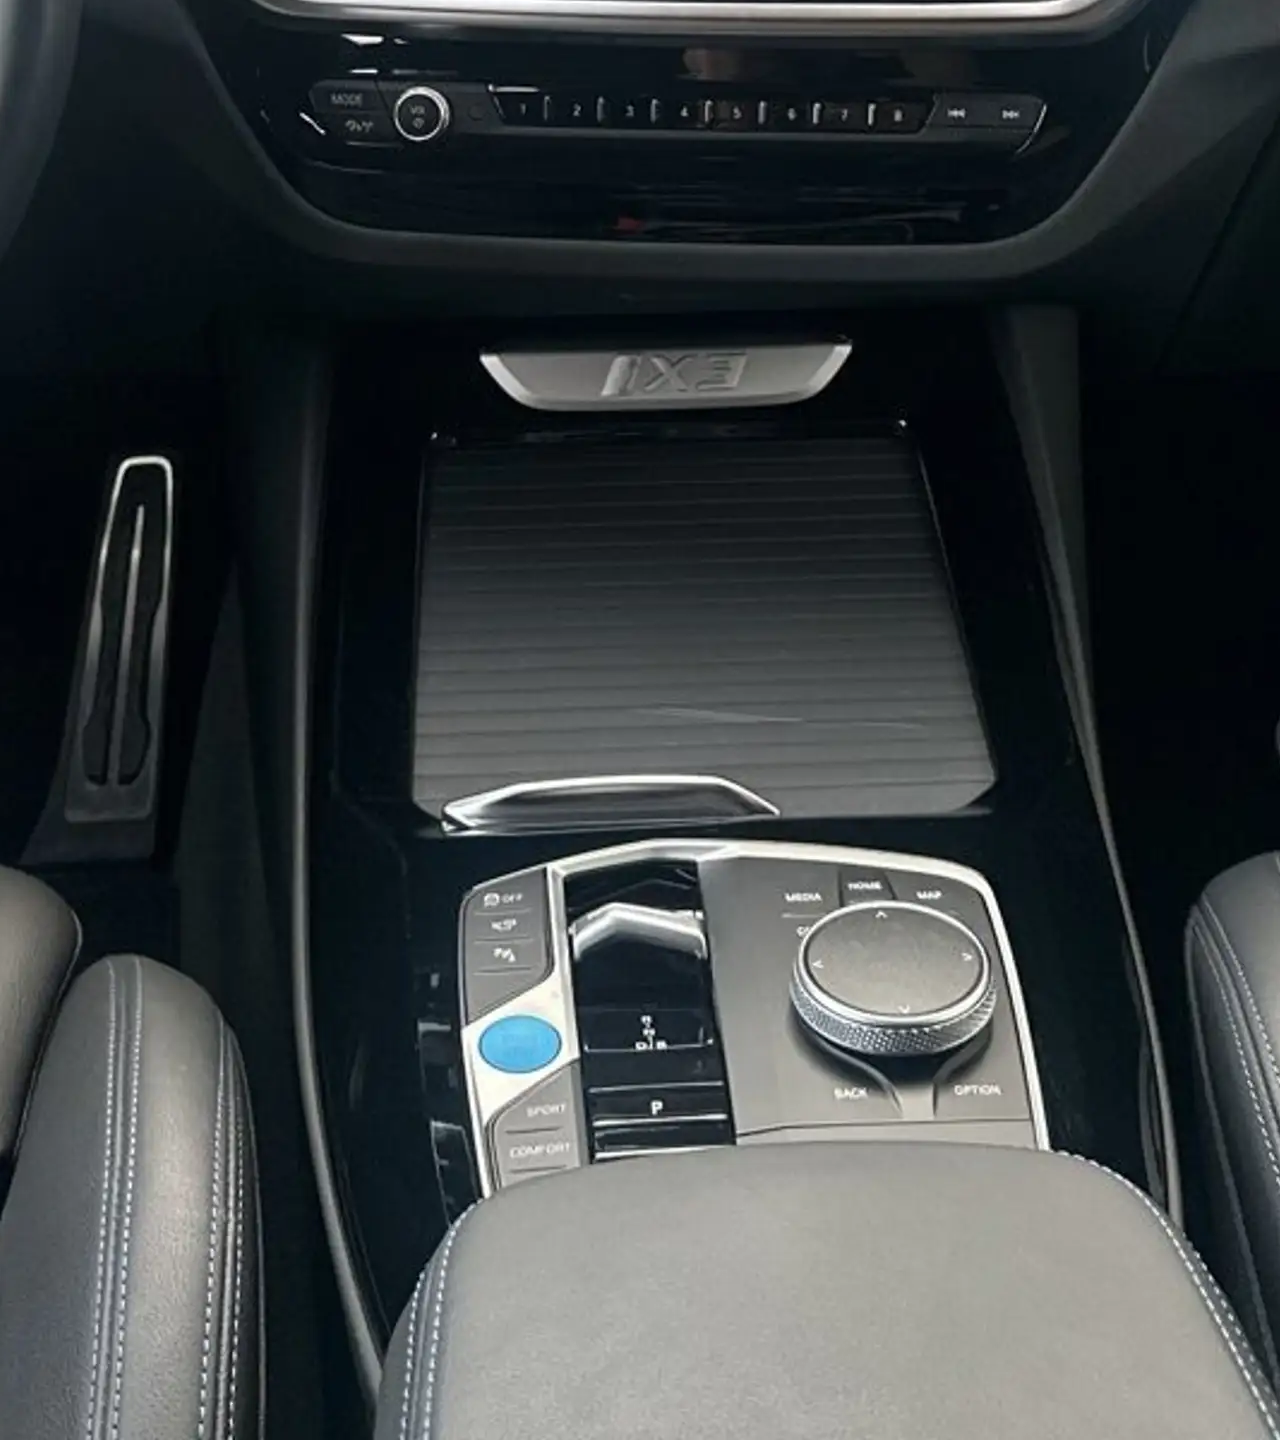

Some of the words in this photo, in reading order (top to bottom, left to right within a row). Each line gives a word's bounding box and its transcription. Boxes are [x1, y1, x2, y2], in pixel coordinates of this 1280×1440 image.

[848, 881, 883, 891] HOME
[785, 893, 822, 902] MEDIA
[917, 891, 942, 900] MAP
[834, 1087, 868, 1100] BACK
[953, 1085, 1002, 1096] OPTION
[526, 1103, 566, 1118] SPORT
[652, 1101, 663, 1115] P
[509, 1141, 570, 1158] COMFORT
